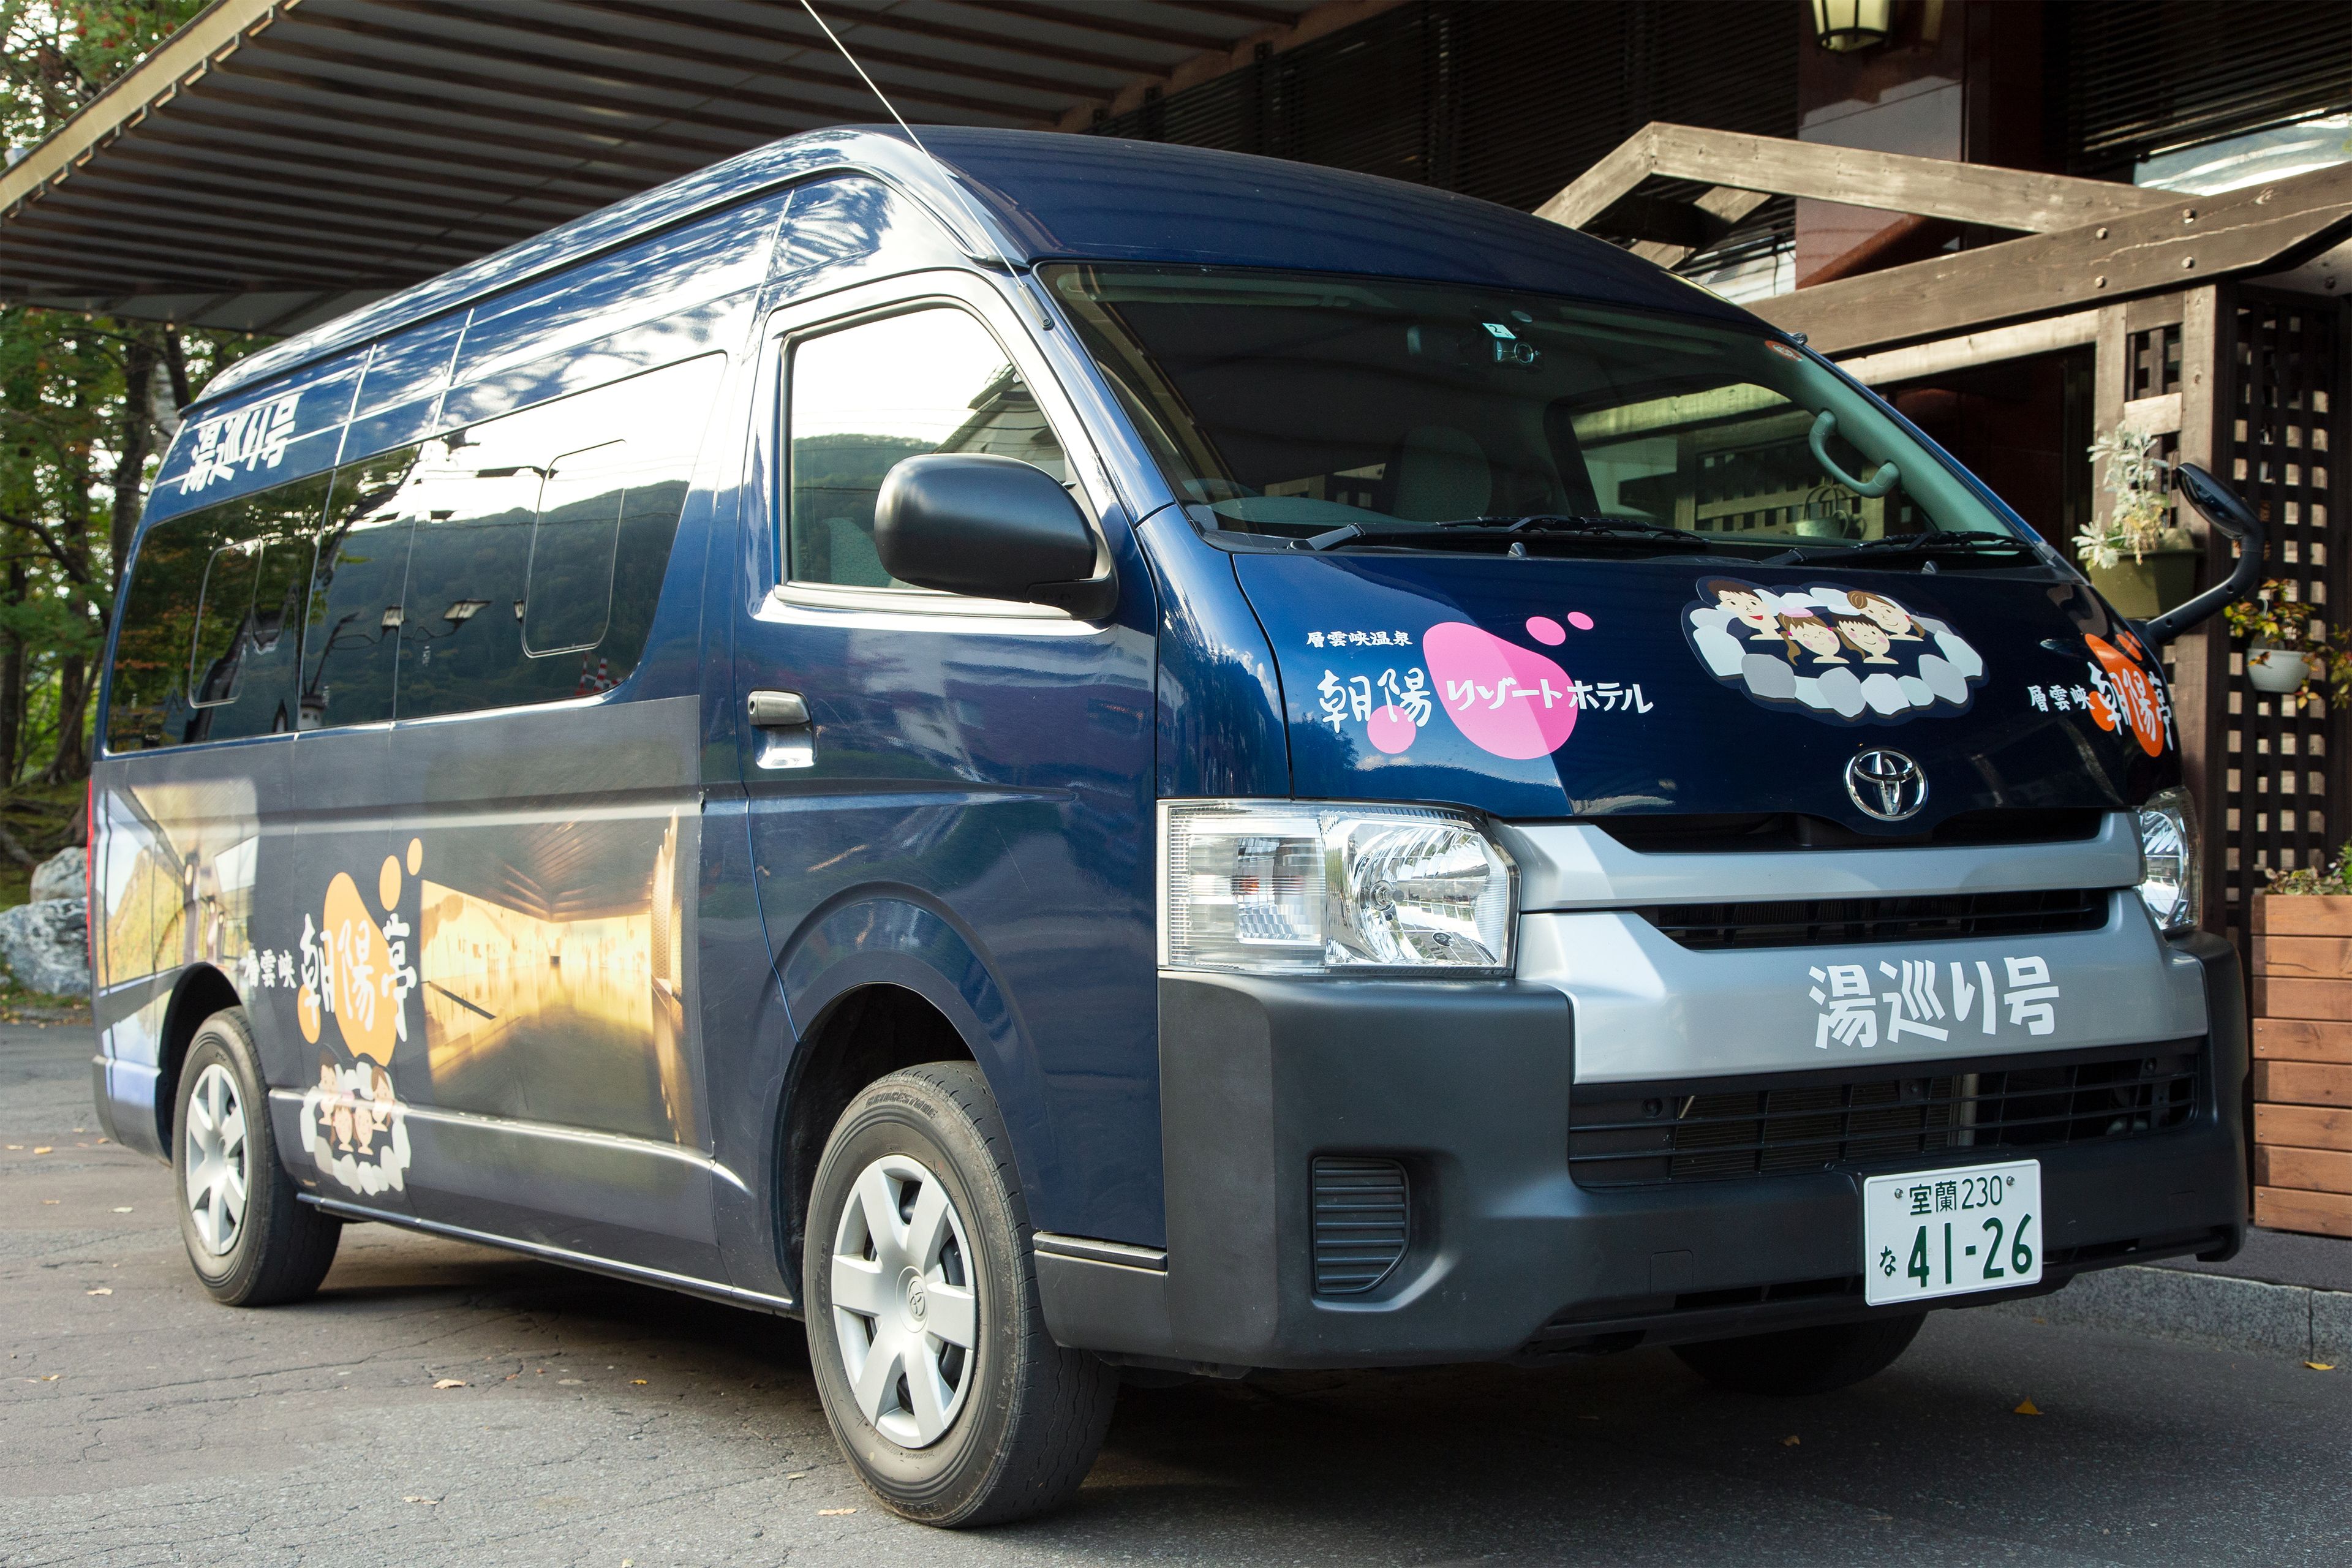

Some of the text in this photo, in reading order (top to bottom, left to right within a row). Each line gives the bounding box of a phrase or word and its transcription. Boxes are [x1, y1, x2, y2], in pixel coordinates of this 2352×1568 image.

[1306, 630, 1413, 648] 層雲峡温泉
[1809, 956, 2059, 1049] 湯巡り号
[1879, 1213, 2032, 1287] な 41-26
